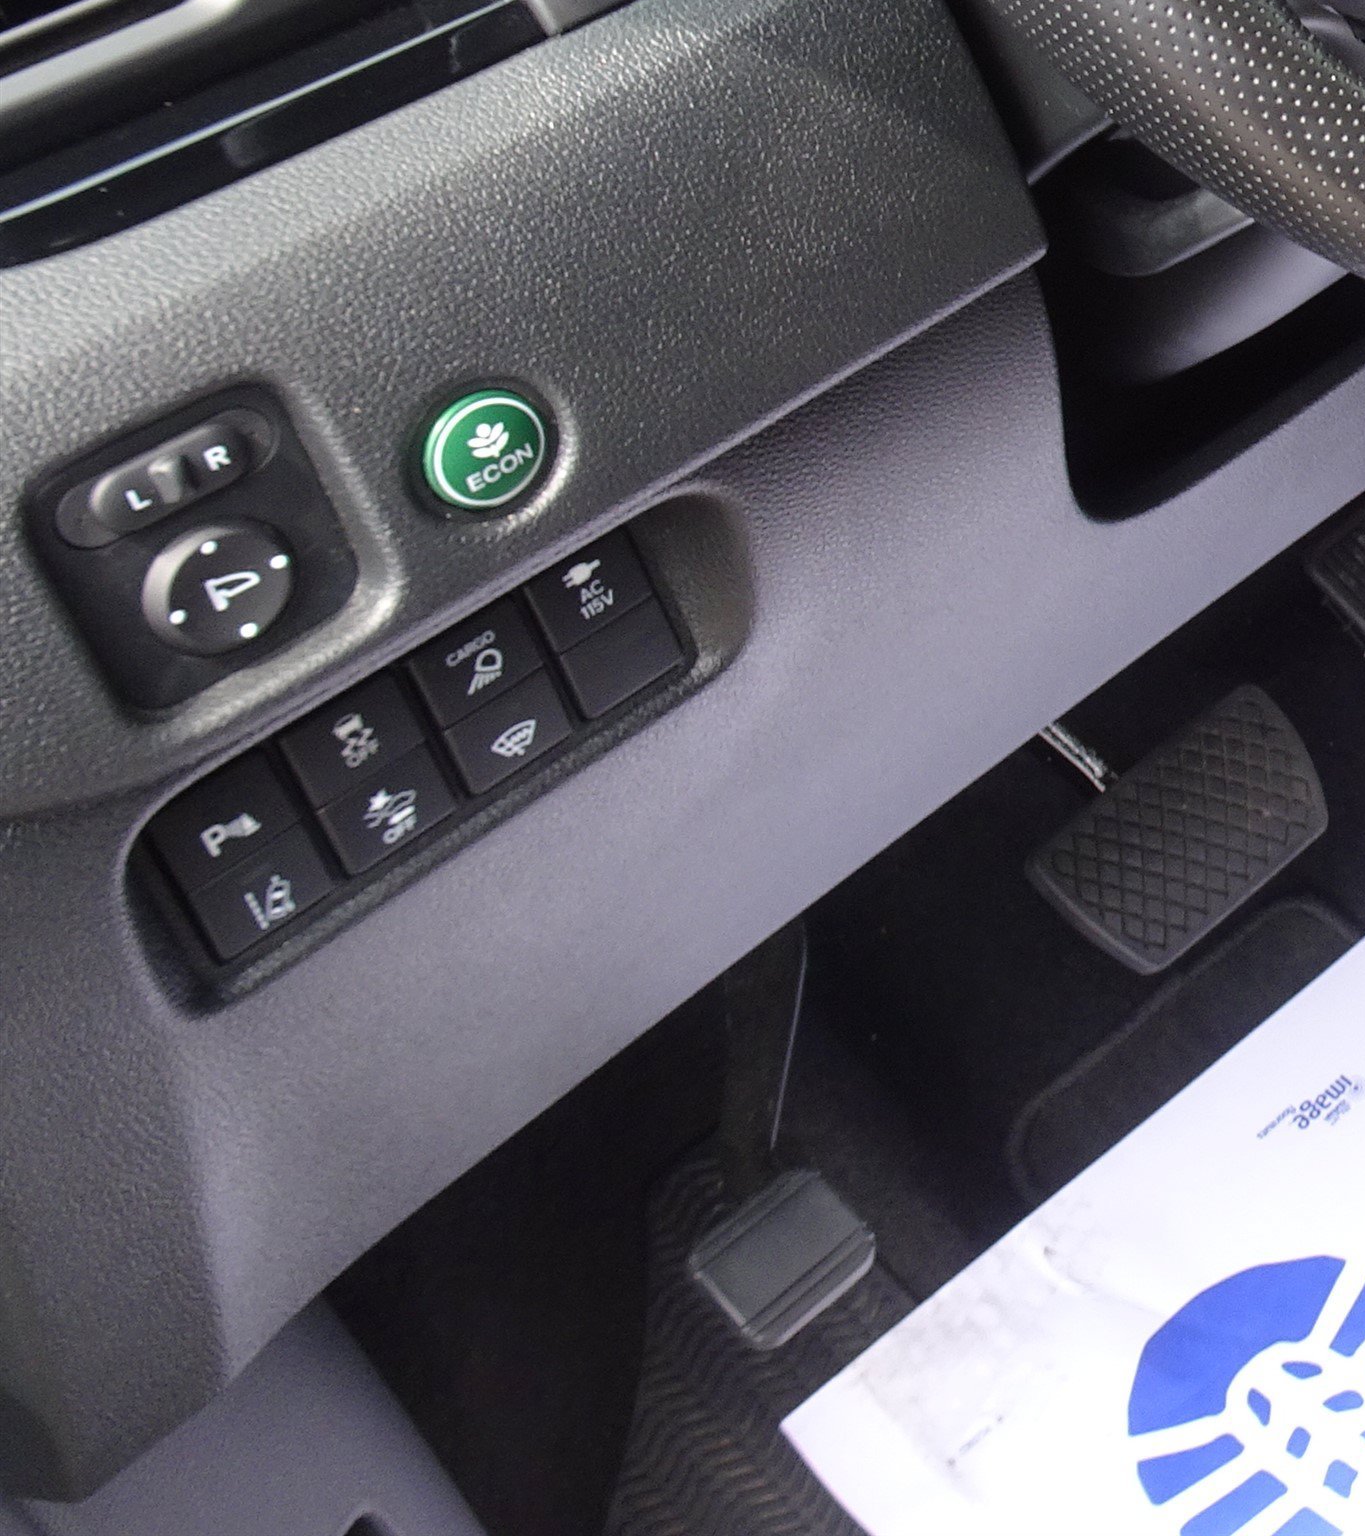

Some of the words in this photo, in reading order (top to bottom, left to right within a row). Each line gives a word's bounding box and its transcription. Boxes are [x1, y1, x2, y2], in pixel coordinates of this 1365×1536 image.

[203, 443, 232, 472] R
[464, 442, 535, 494] ECON
[125, 487, 153, 512] L
[579, 588, 616, 621] 115V
[580, 578, 605, 605] AC
[445, 629, 496, 668] CARGO
[1291, 1073, 1358, 1130] image
